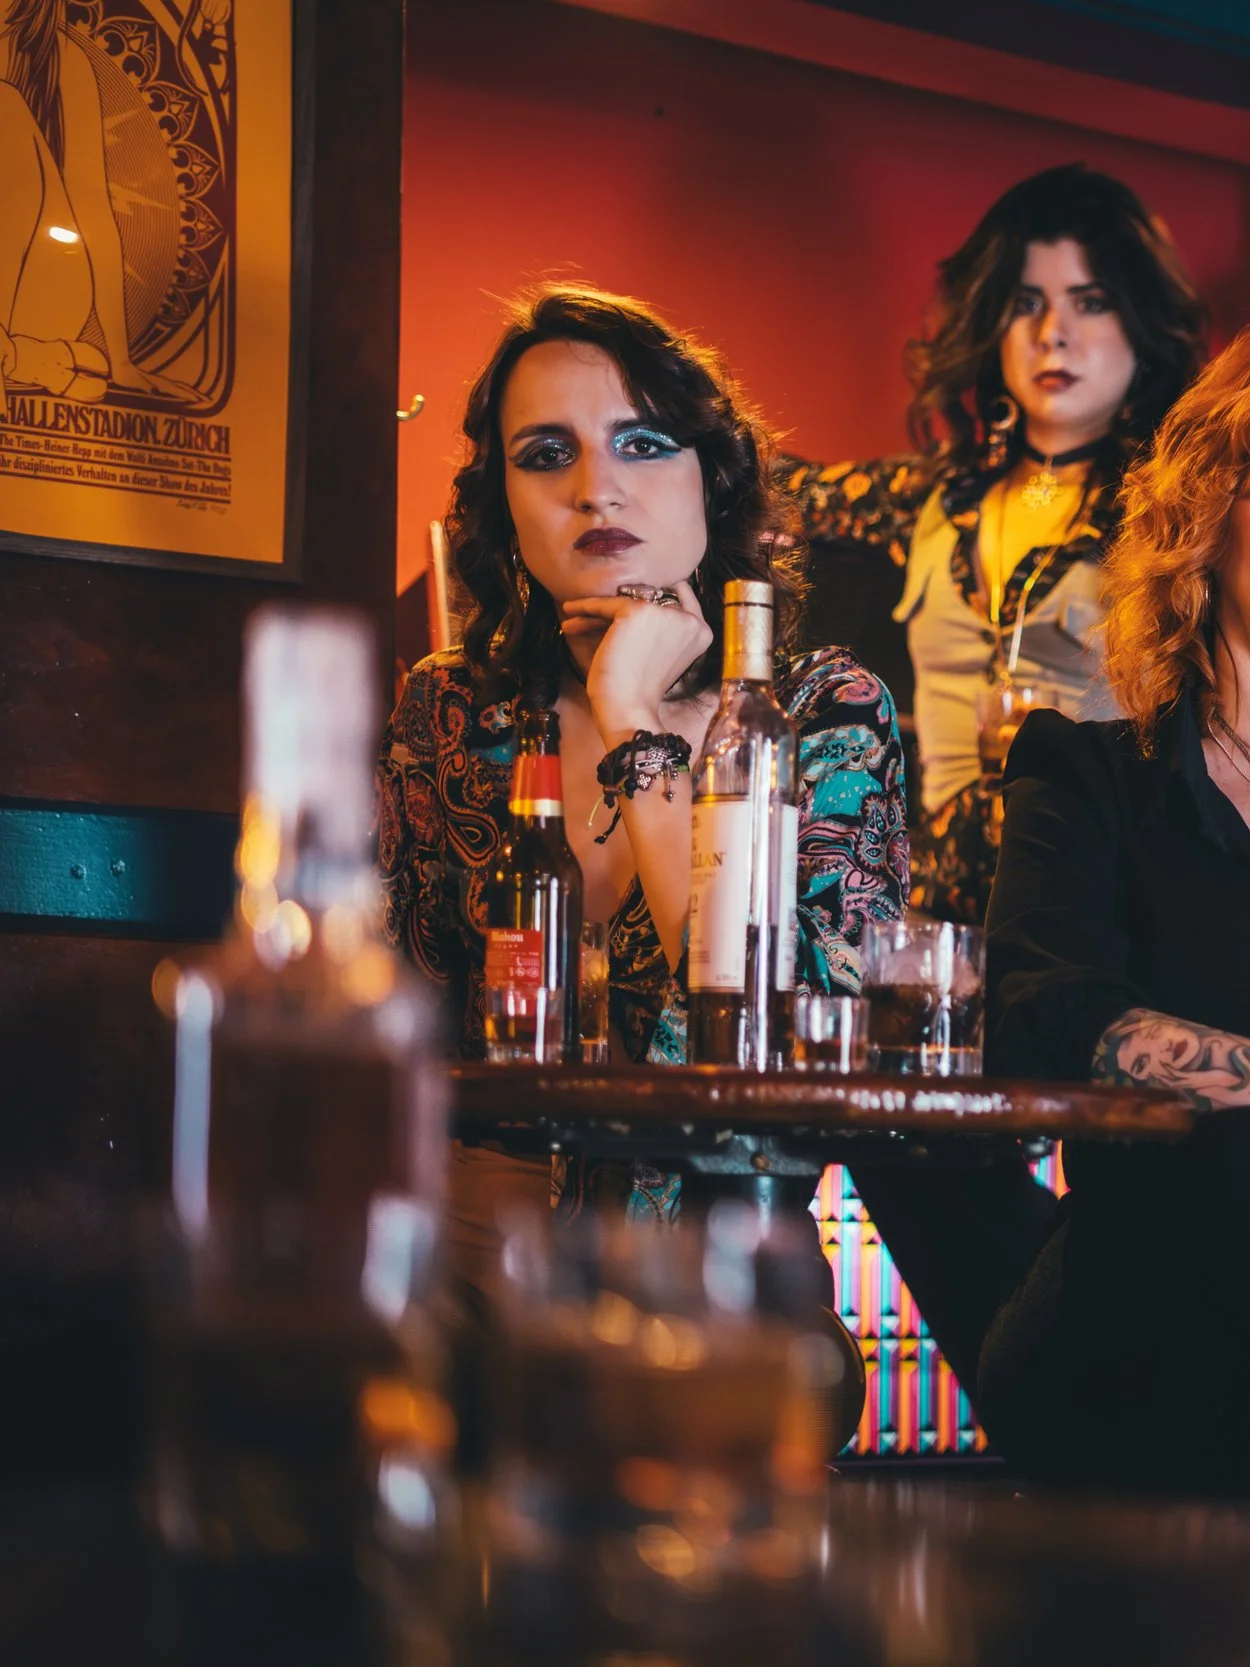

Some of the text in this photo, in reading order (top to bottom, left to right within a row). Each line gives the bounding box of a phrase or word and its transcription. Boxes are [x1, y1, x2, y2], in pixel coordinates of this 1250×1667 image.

[162, 416, 230, 454] ZÜRICH
[94, 448, 107, 458] mit
[76, 463, 117, 482] Verhalten
